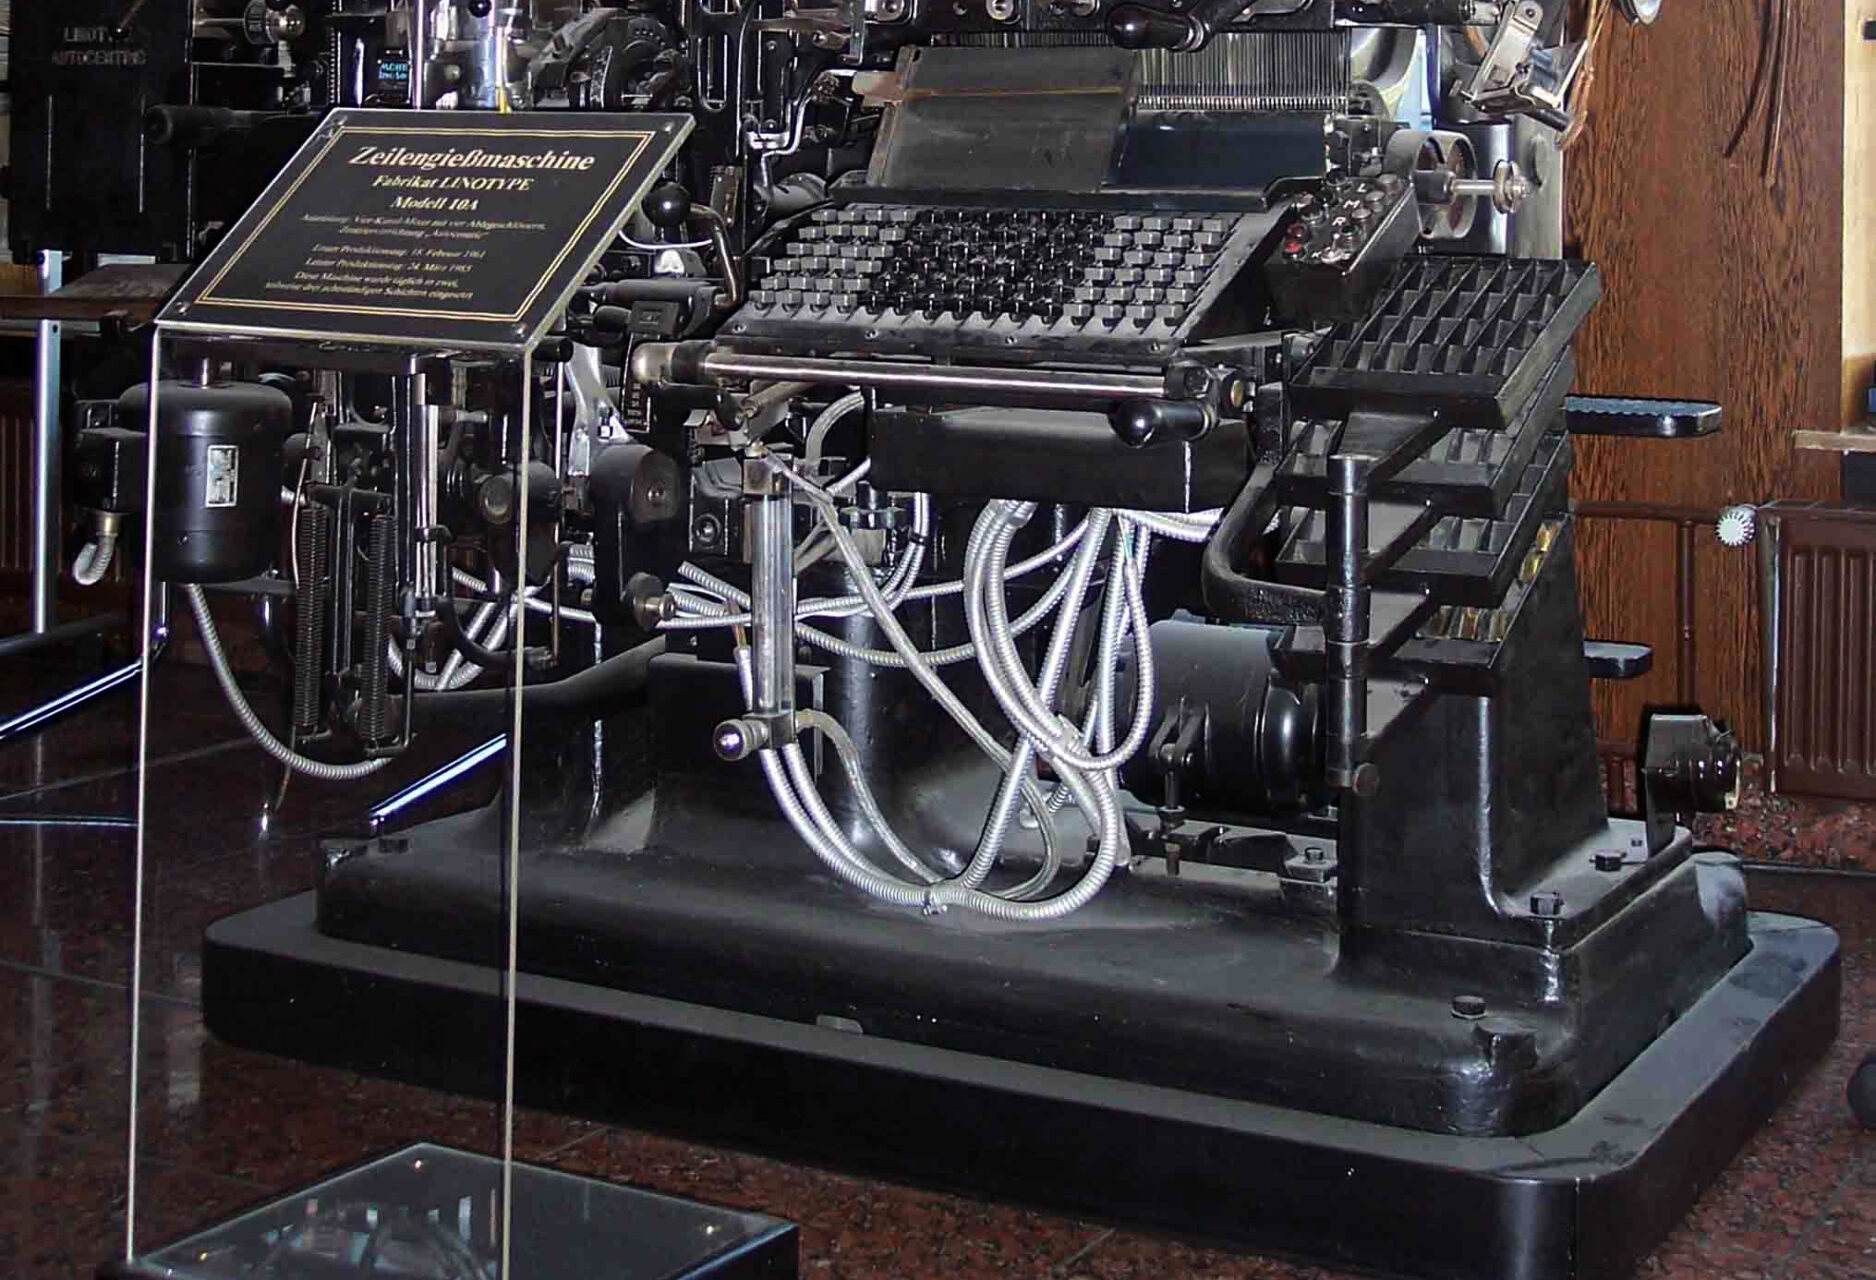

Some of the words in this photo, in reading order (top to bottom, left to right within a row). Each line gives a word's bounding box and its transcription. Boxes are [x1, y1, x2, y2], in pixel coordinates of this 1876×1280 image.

[348, 146, 597, 171] Zeilengießmaschine
[371, 174, 439, 190] Fabrikat
[438, 176, 535, 191] LINOTYPE
[390, 196, 447, 210] Modell
[447, 198, 480, 211] 10A
[1343, 200, 1360, 208] M
[1332, 216, 1346, 226] R
